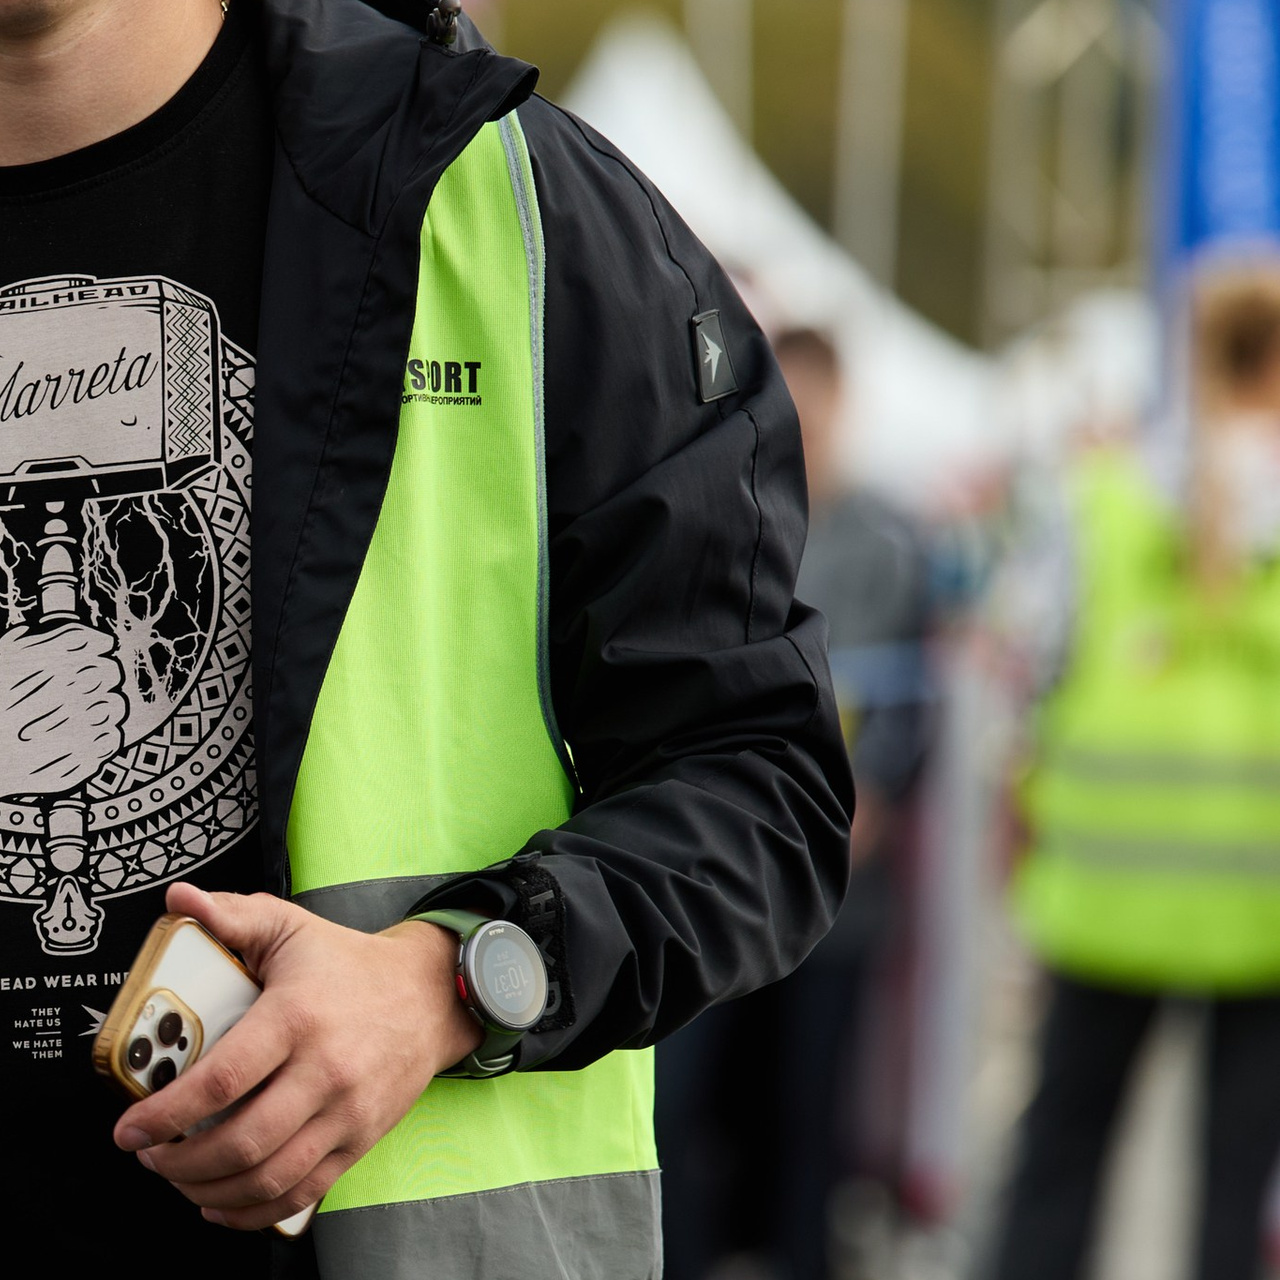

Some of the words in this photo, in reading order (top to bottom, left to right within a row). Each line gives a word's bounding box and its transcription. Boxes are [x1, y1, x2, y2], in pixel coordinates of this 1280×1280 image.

[43, 974, 98, 989] WEAR
[31, 1007, 61, 1017] THEY
[14, 1019, 43, 1029] HATE
[46, 1018, 61, 1027] US
[12, 1040, 30, 1049] WE
[33, 1039, 63, 1049] HATE
[31, 1050, 63, 1059] THEM
